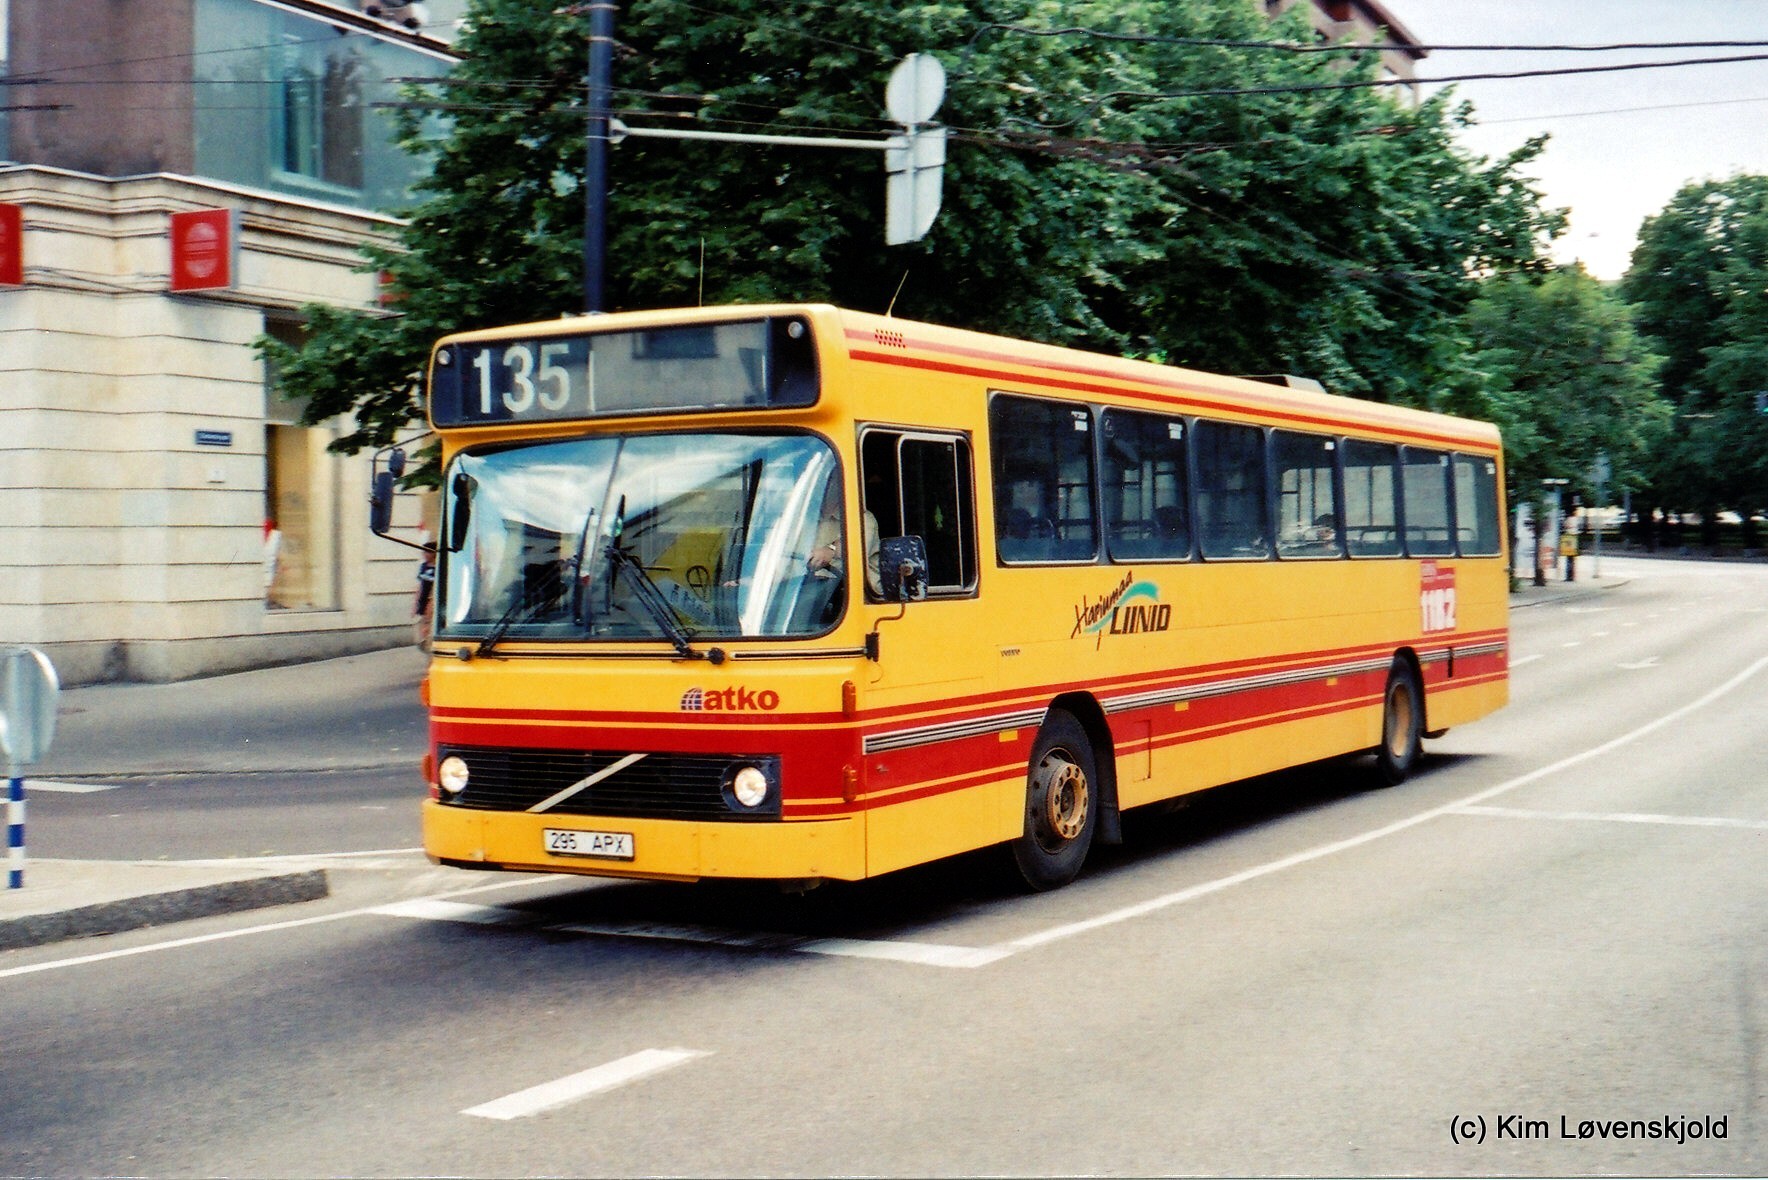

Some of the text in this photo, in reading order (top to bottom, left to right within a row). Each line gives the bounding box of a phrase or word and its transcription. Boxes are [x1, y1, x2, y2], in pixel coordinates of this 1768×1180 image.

[473, 344, 571, 414] 135
[1110, 604, 1171, 634] LIINID
[704, 686, 780, 711] atko
[552, 833, 624, 853] 295 APX
